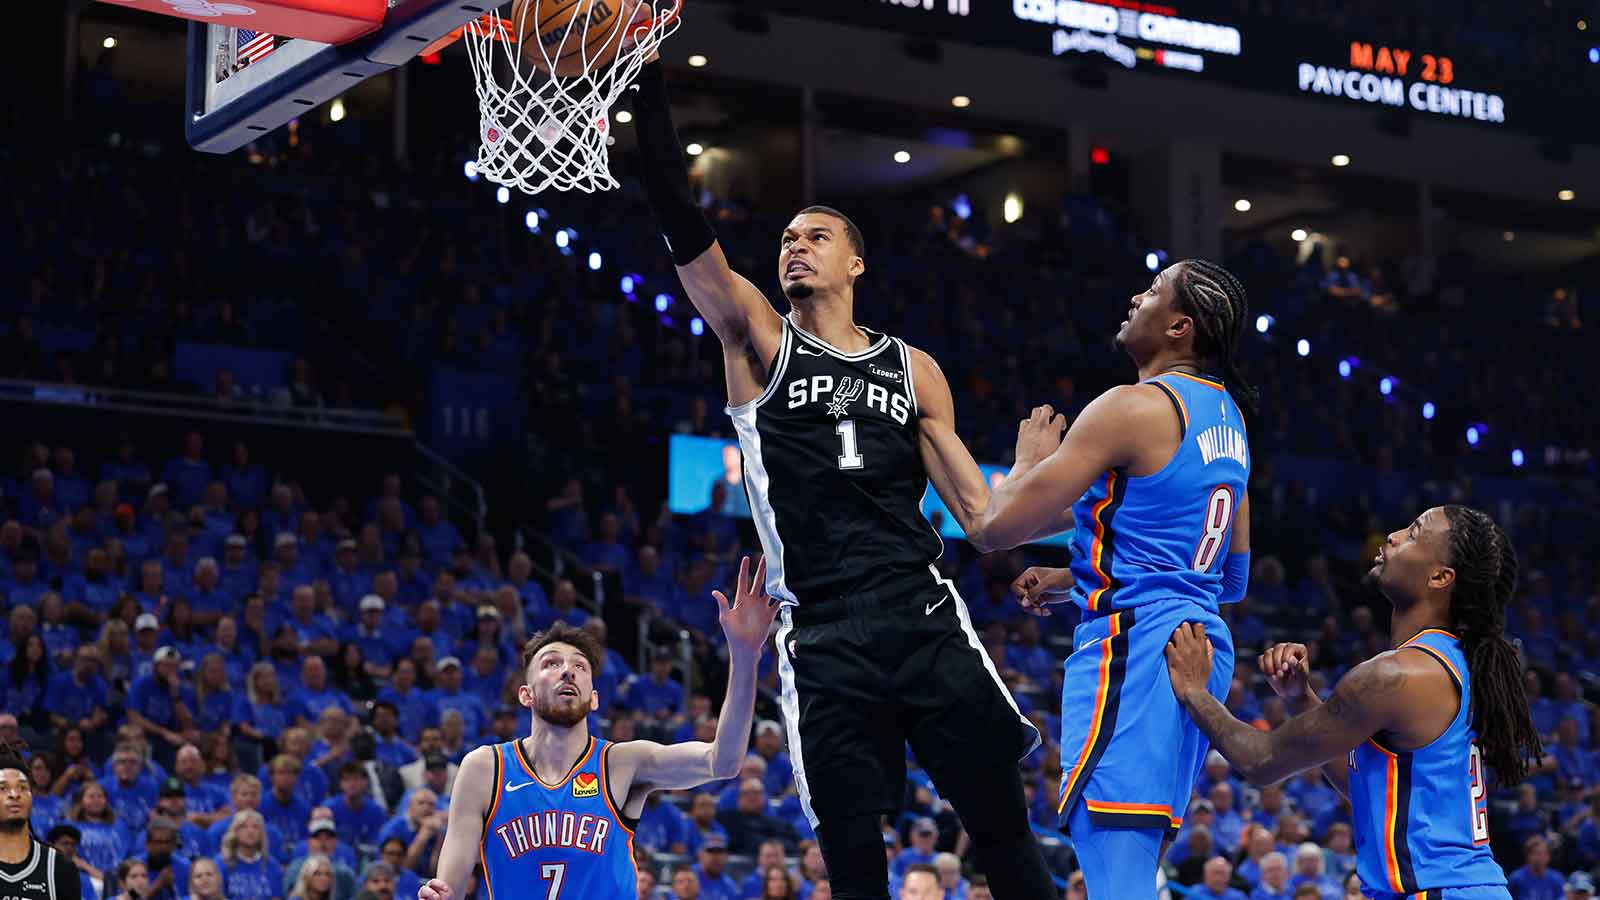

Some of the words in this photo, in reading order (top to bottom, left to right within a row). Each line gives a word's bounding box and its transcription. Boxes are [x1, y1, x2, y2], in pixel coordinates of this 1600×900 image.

[1350, 42, 1411, 76] MAY
[1421, 54, 1454, 84] 23
[1299, 63, 1404, 106] PAYCOM
[1409, 82, 1505, 123] CENTER
[872, 367, 899, 379] LEDGER
[788, 375, 910, 425] SPURS
[835, 420, 864, 470] 1
[1191, 483, 1234, 573] 8
[496, 810, 609, 860] THUNDER
[540, 862, 568, 900] 7
